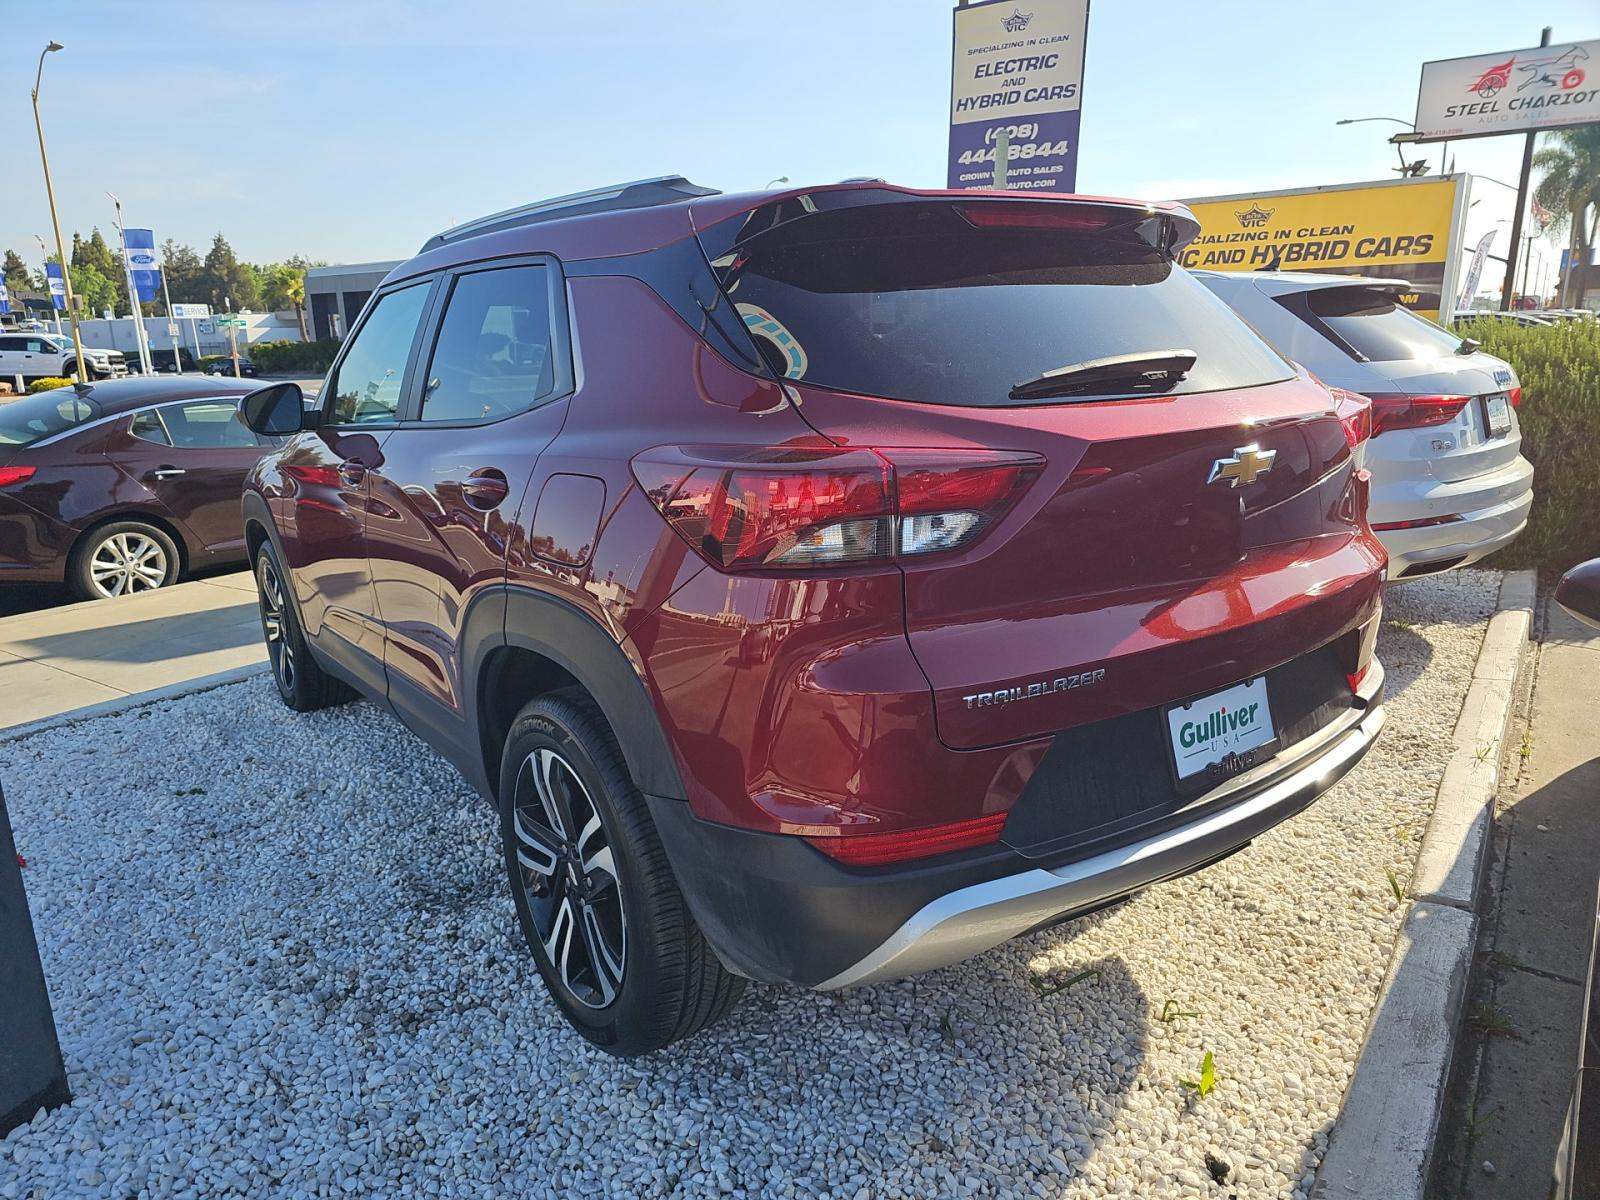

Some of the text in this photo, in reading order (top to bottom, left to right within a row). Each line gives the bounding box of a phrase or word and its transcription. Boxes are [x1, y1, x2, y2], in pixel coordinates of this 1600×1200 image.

[1006, 24, 1026, 32] VIC
[967, 40, 1024, 55] SPECIALIZING
[1039, 34, 1070, 45] CLEAN
[974, 53, 1059, 79] ELECTRIC
[1001, 77, 1026, 88] AND
[956, 83, 1077, 112] HYBRID CARS
[1444, 90, 1599, 118] STEEL CHARIOT
[959, 171, 990, 181] CROWN
[1006, 168, 1032, 177] AUTO
[1033, 165, 1064, 174] SALES
[1190, 225, 1355, 245] CIALIZING IN CLEAN
[1241, 219, 1266, 228] VIC
[1202, 248, 1246, 266] AND
[1249, 239, 1350, 265] HYBRID
[1353, 234, 1434, 259] CARS
[962, 668, 1105, 709] TRAILBLAZER
[1179, 702, 1259, 748] Gulliver
